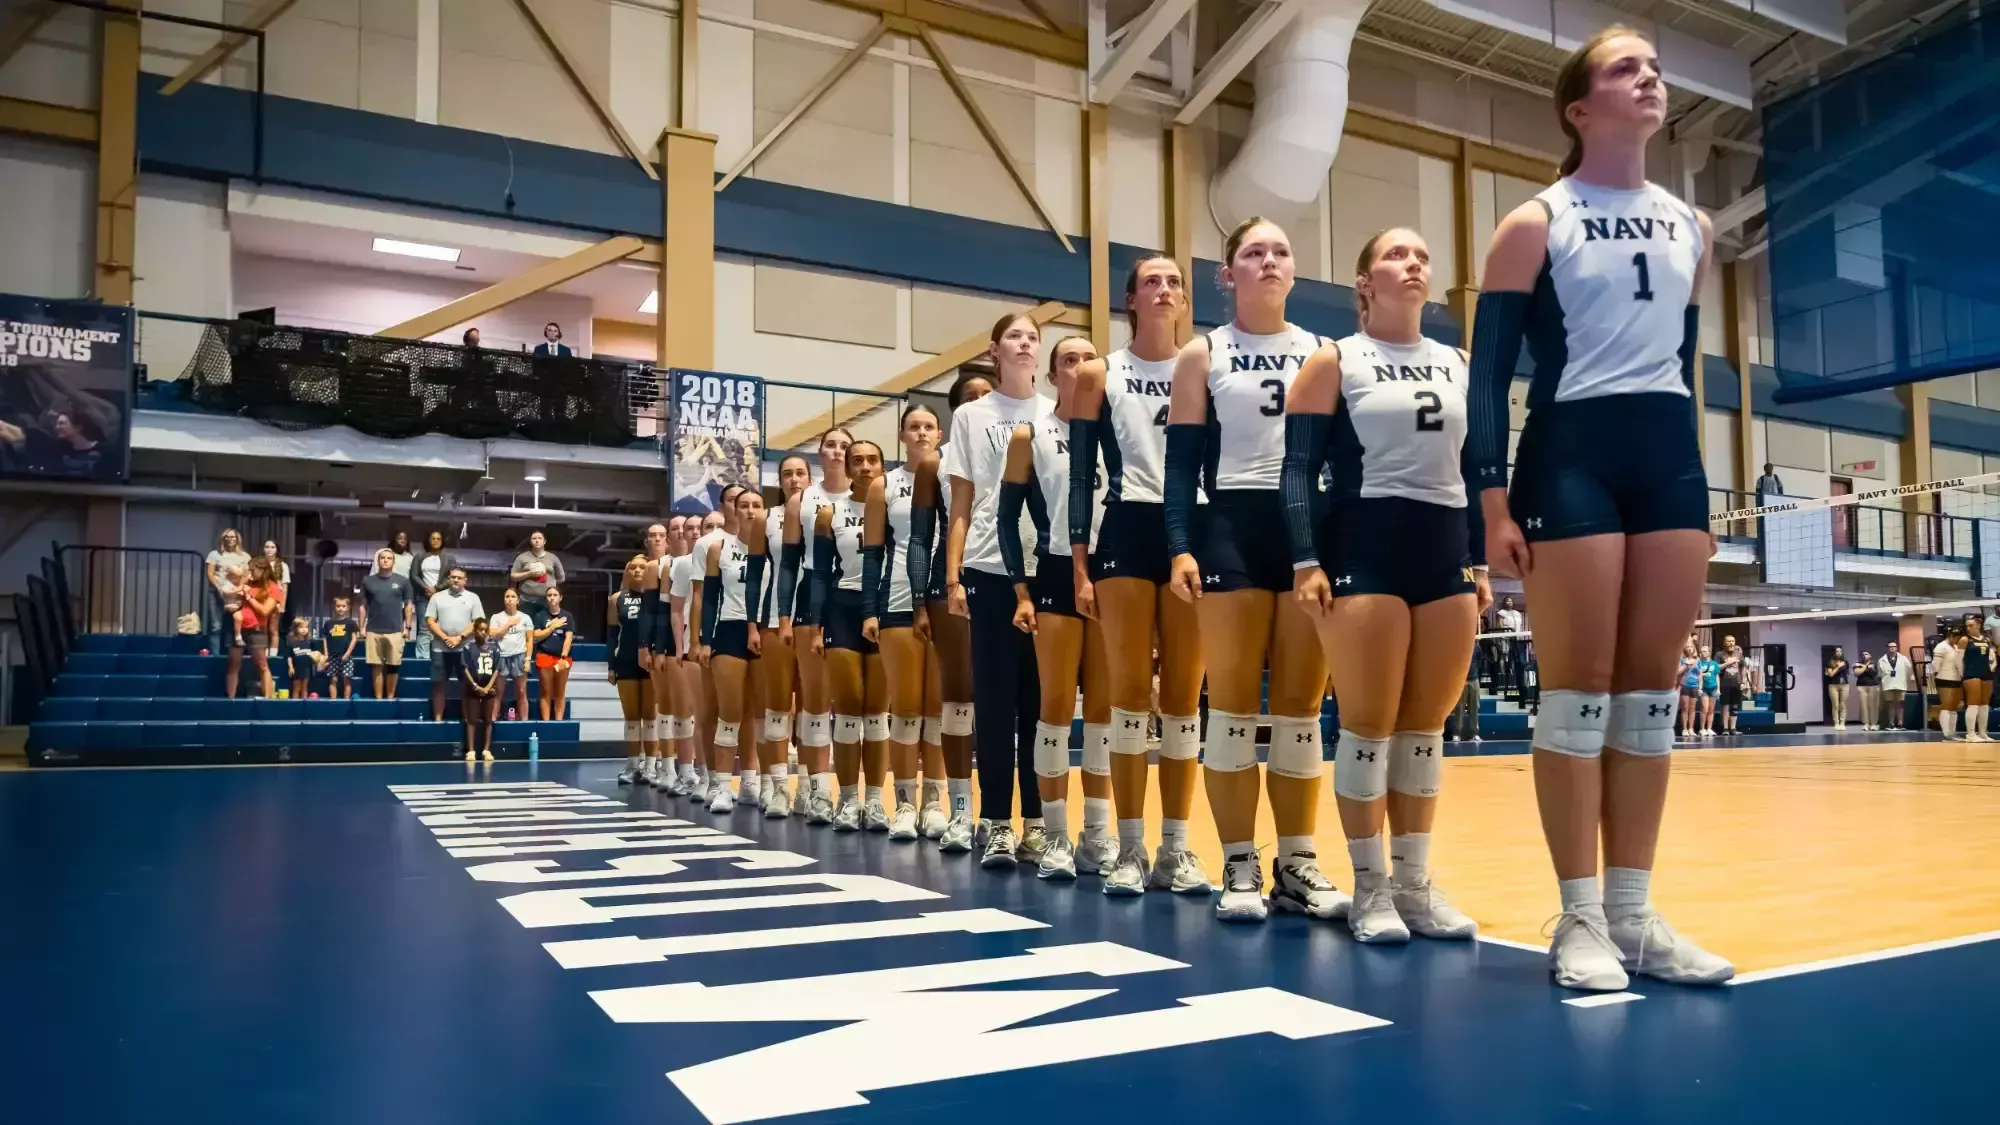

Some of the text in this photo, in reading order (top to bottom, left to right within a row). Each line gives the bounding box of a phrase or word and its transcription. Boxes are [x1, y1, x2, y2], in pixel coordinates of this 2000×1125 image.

[1581, 217, 1677, 242] NAVY
[1631, 252, 1653, 300] 1
[10, 321, 120, 344] TOURNAMENT
[1229, 354, 1306, 373] NAVY
[1372, 364, 1453, 383] NAVY
[681, 374, 755, 408] 2018
[1126, 378, 1172, 397] NAV
[1259, 379, 1285, 417] 3
[680, 401, 755, 431] NCAA
[1413, 391, 1445, 432] 2
[1857, 478, 1965, 501] NAVY VOLLEYBALL
[1710, 502, 1798, 521] NAVY VOLLEYBALL
[1461, 567, 1476, 583] N
[477, 656, 493, 675] 12
[388, 782, 1391, 1125] MIDSHIPMEN
